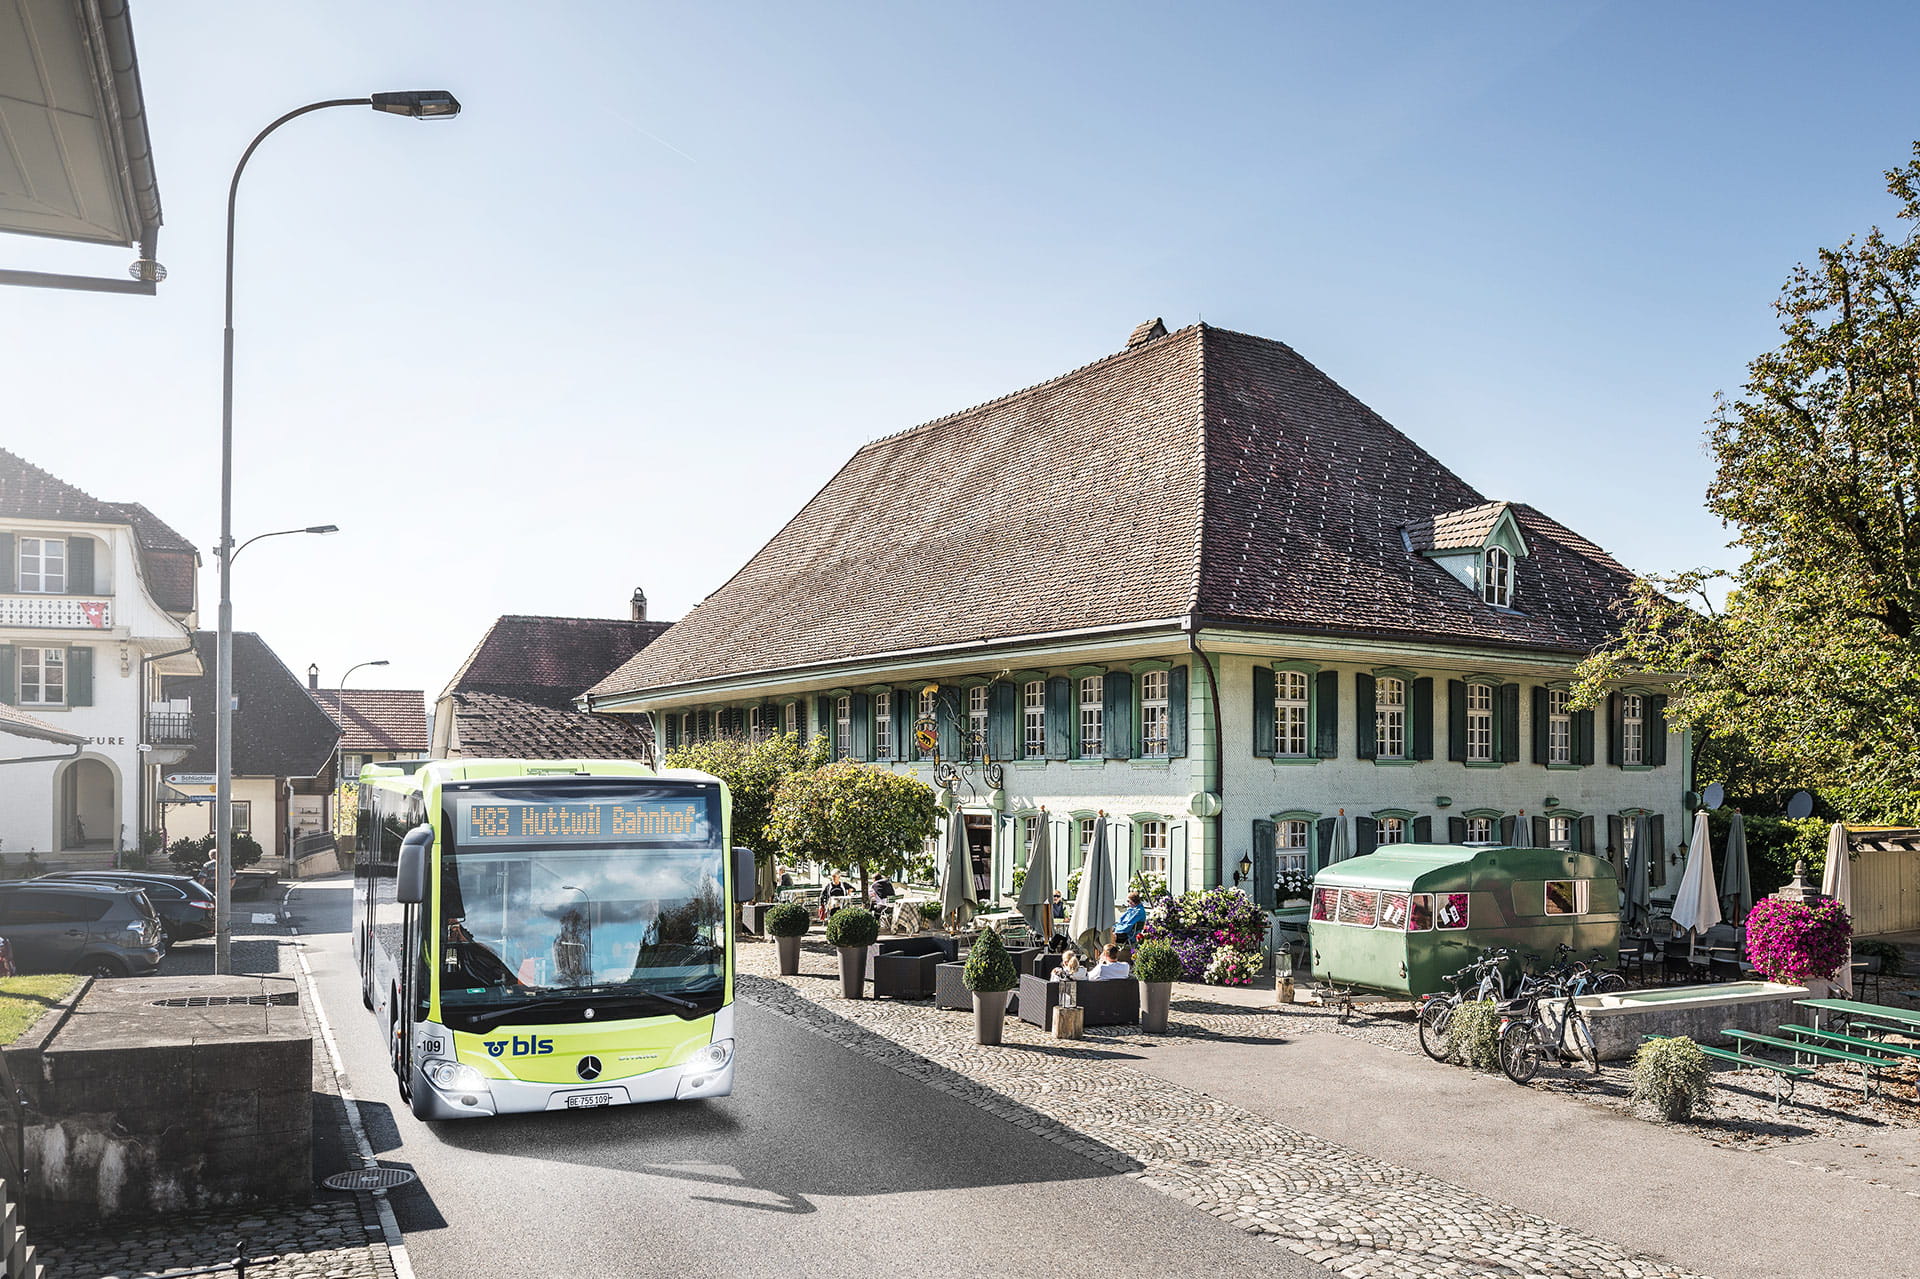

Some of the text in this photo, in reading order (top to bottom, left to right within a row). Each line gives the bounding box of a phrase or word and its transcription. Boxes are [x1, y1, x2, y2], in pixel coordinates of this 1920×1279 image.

[471, 803, 696, 836] 483 Huttwil Bahnhof
[422, 1040, 441, 1052] 109
[512, 1034, 554, 1056] bls
